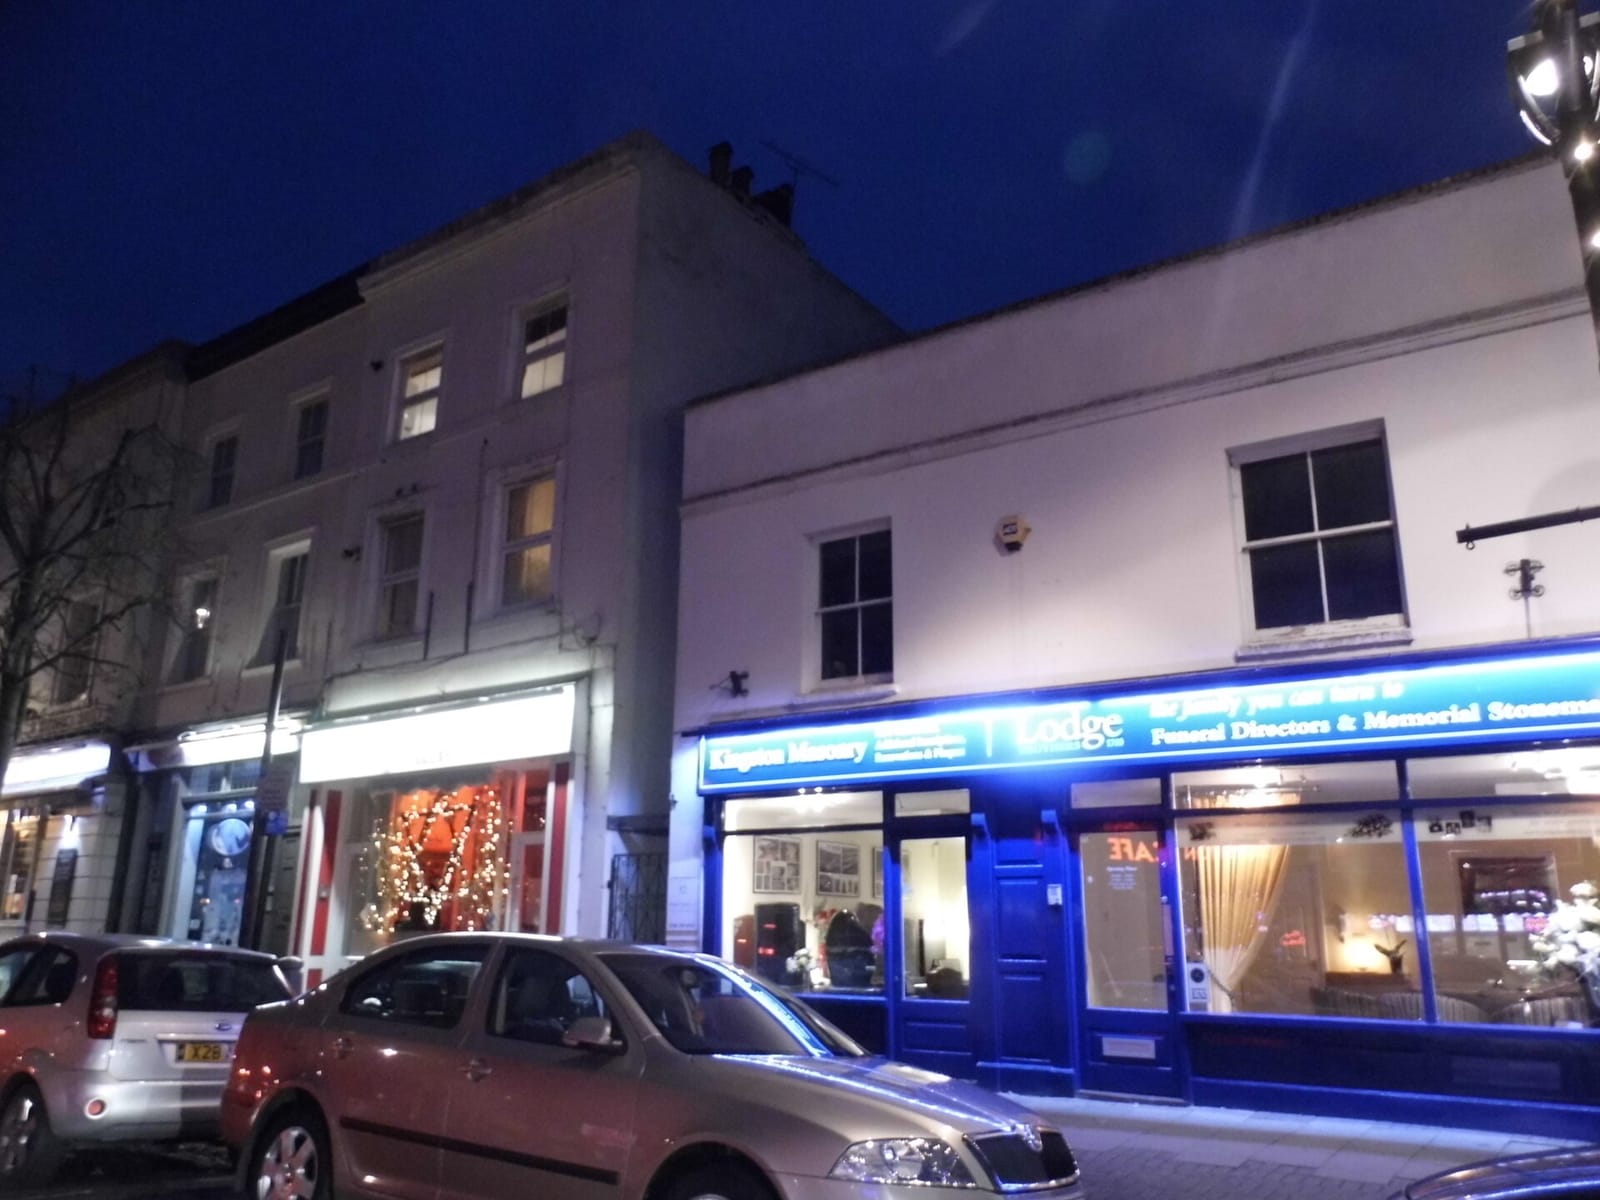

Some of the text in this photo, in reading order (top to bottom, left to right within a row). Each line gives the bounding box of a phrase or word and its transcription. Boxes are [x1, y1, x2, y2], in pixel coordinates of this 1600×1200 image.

[1016, 706, 1124, 750] Lodge
[1151, 724, 1226, 745] Funeral
[1231, 717, 1331, 740] Directors
[1337, 714, 1357, 731] &
[1363, 703, 1481, 730] Memorial
[709, 748, 785, 773] Kingston
